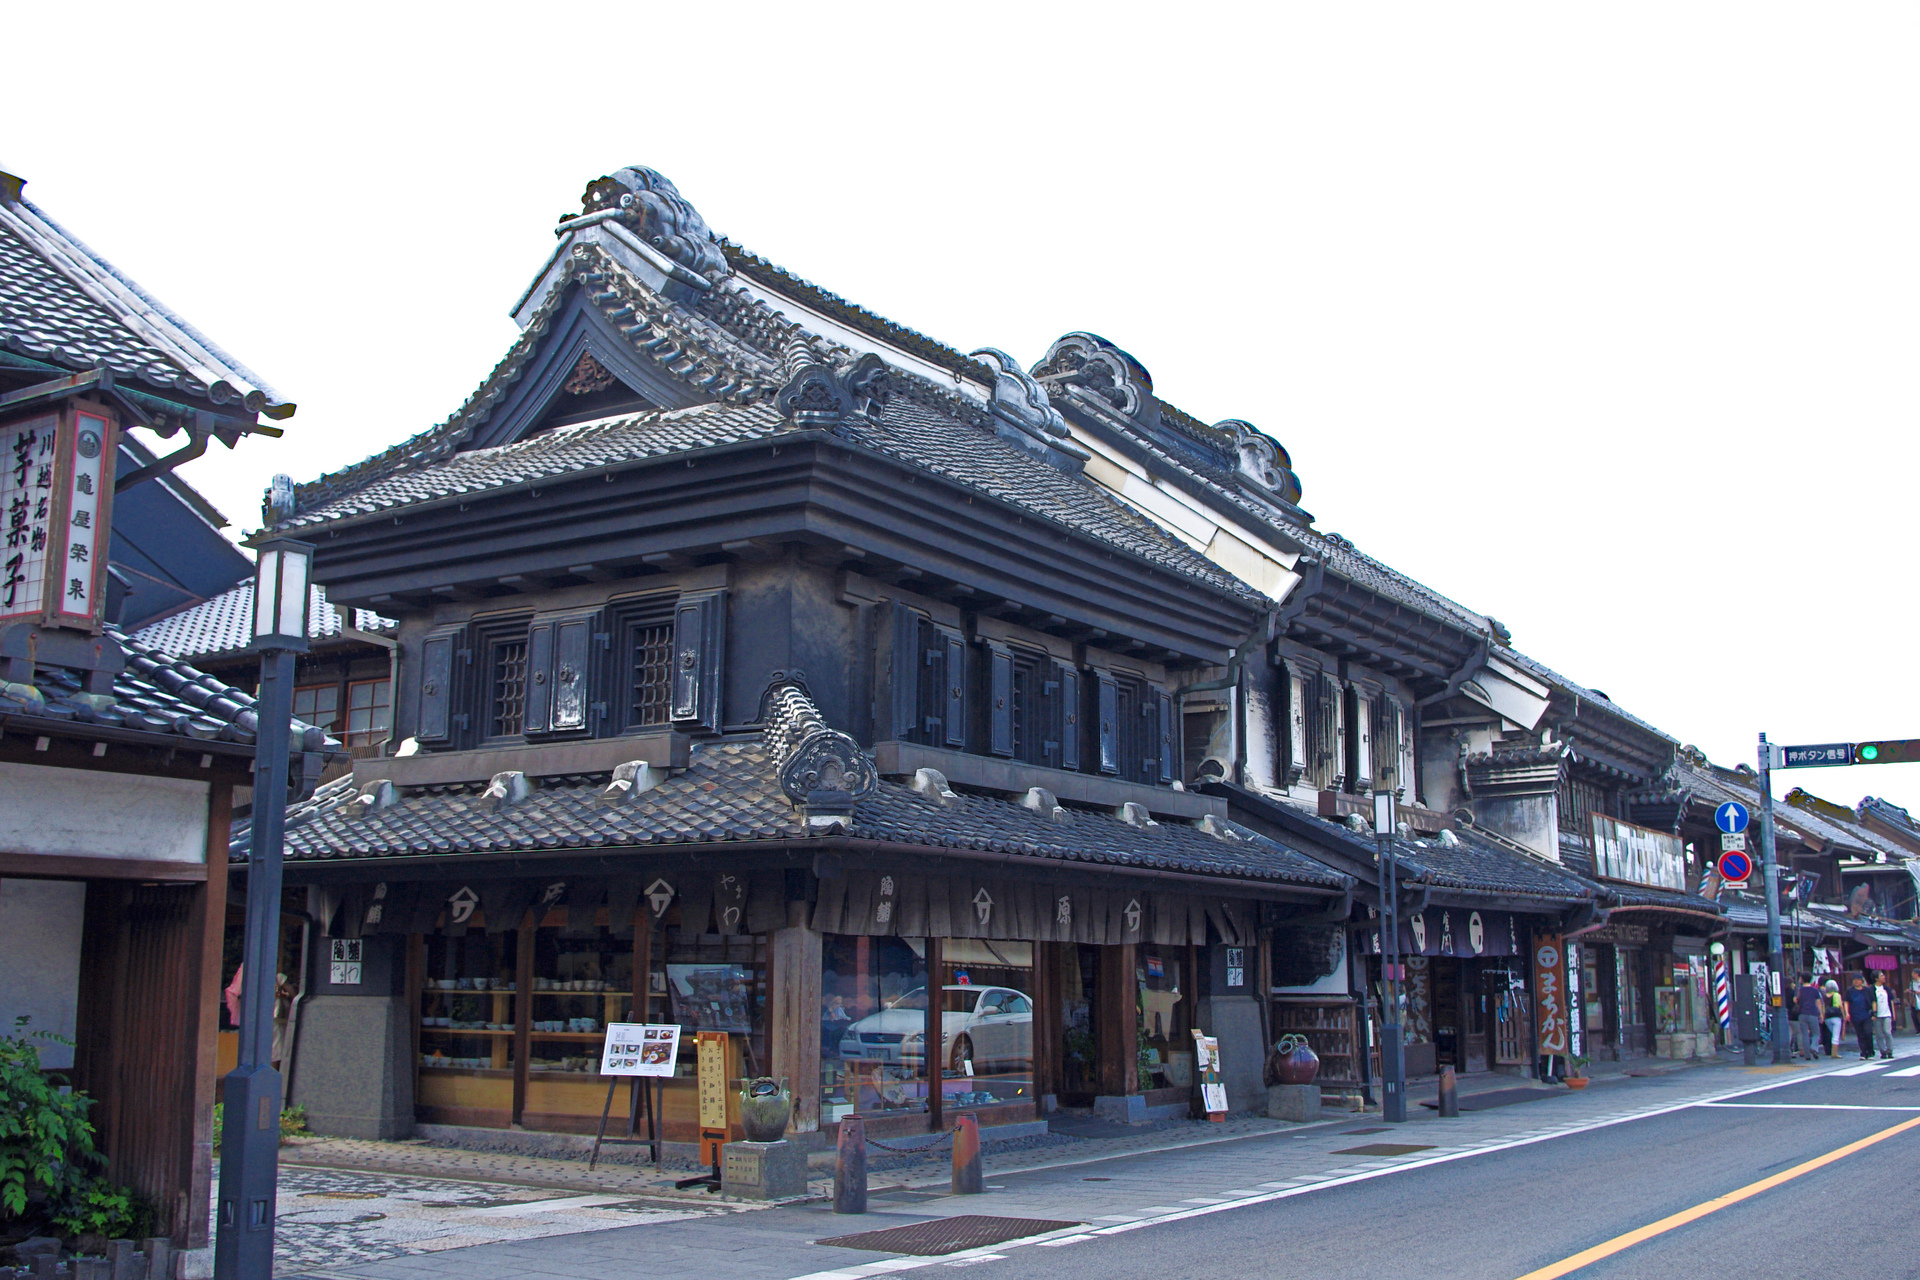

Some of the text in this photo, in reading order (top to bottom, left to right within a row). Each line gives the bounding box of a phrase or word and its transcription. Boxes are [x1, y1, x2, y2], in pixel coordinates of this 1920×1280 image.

[3, 429, 37, 608] 芋菓子
[31, 429, 56, 552] 川越名物
[1788, 748, 1846, 762] 押ボタン信号
[1540, 972, 1565, 1051] まちかん
